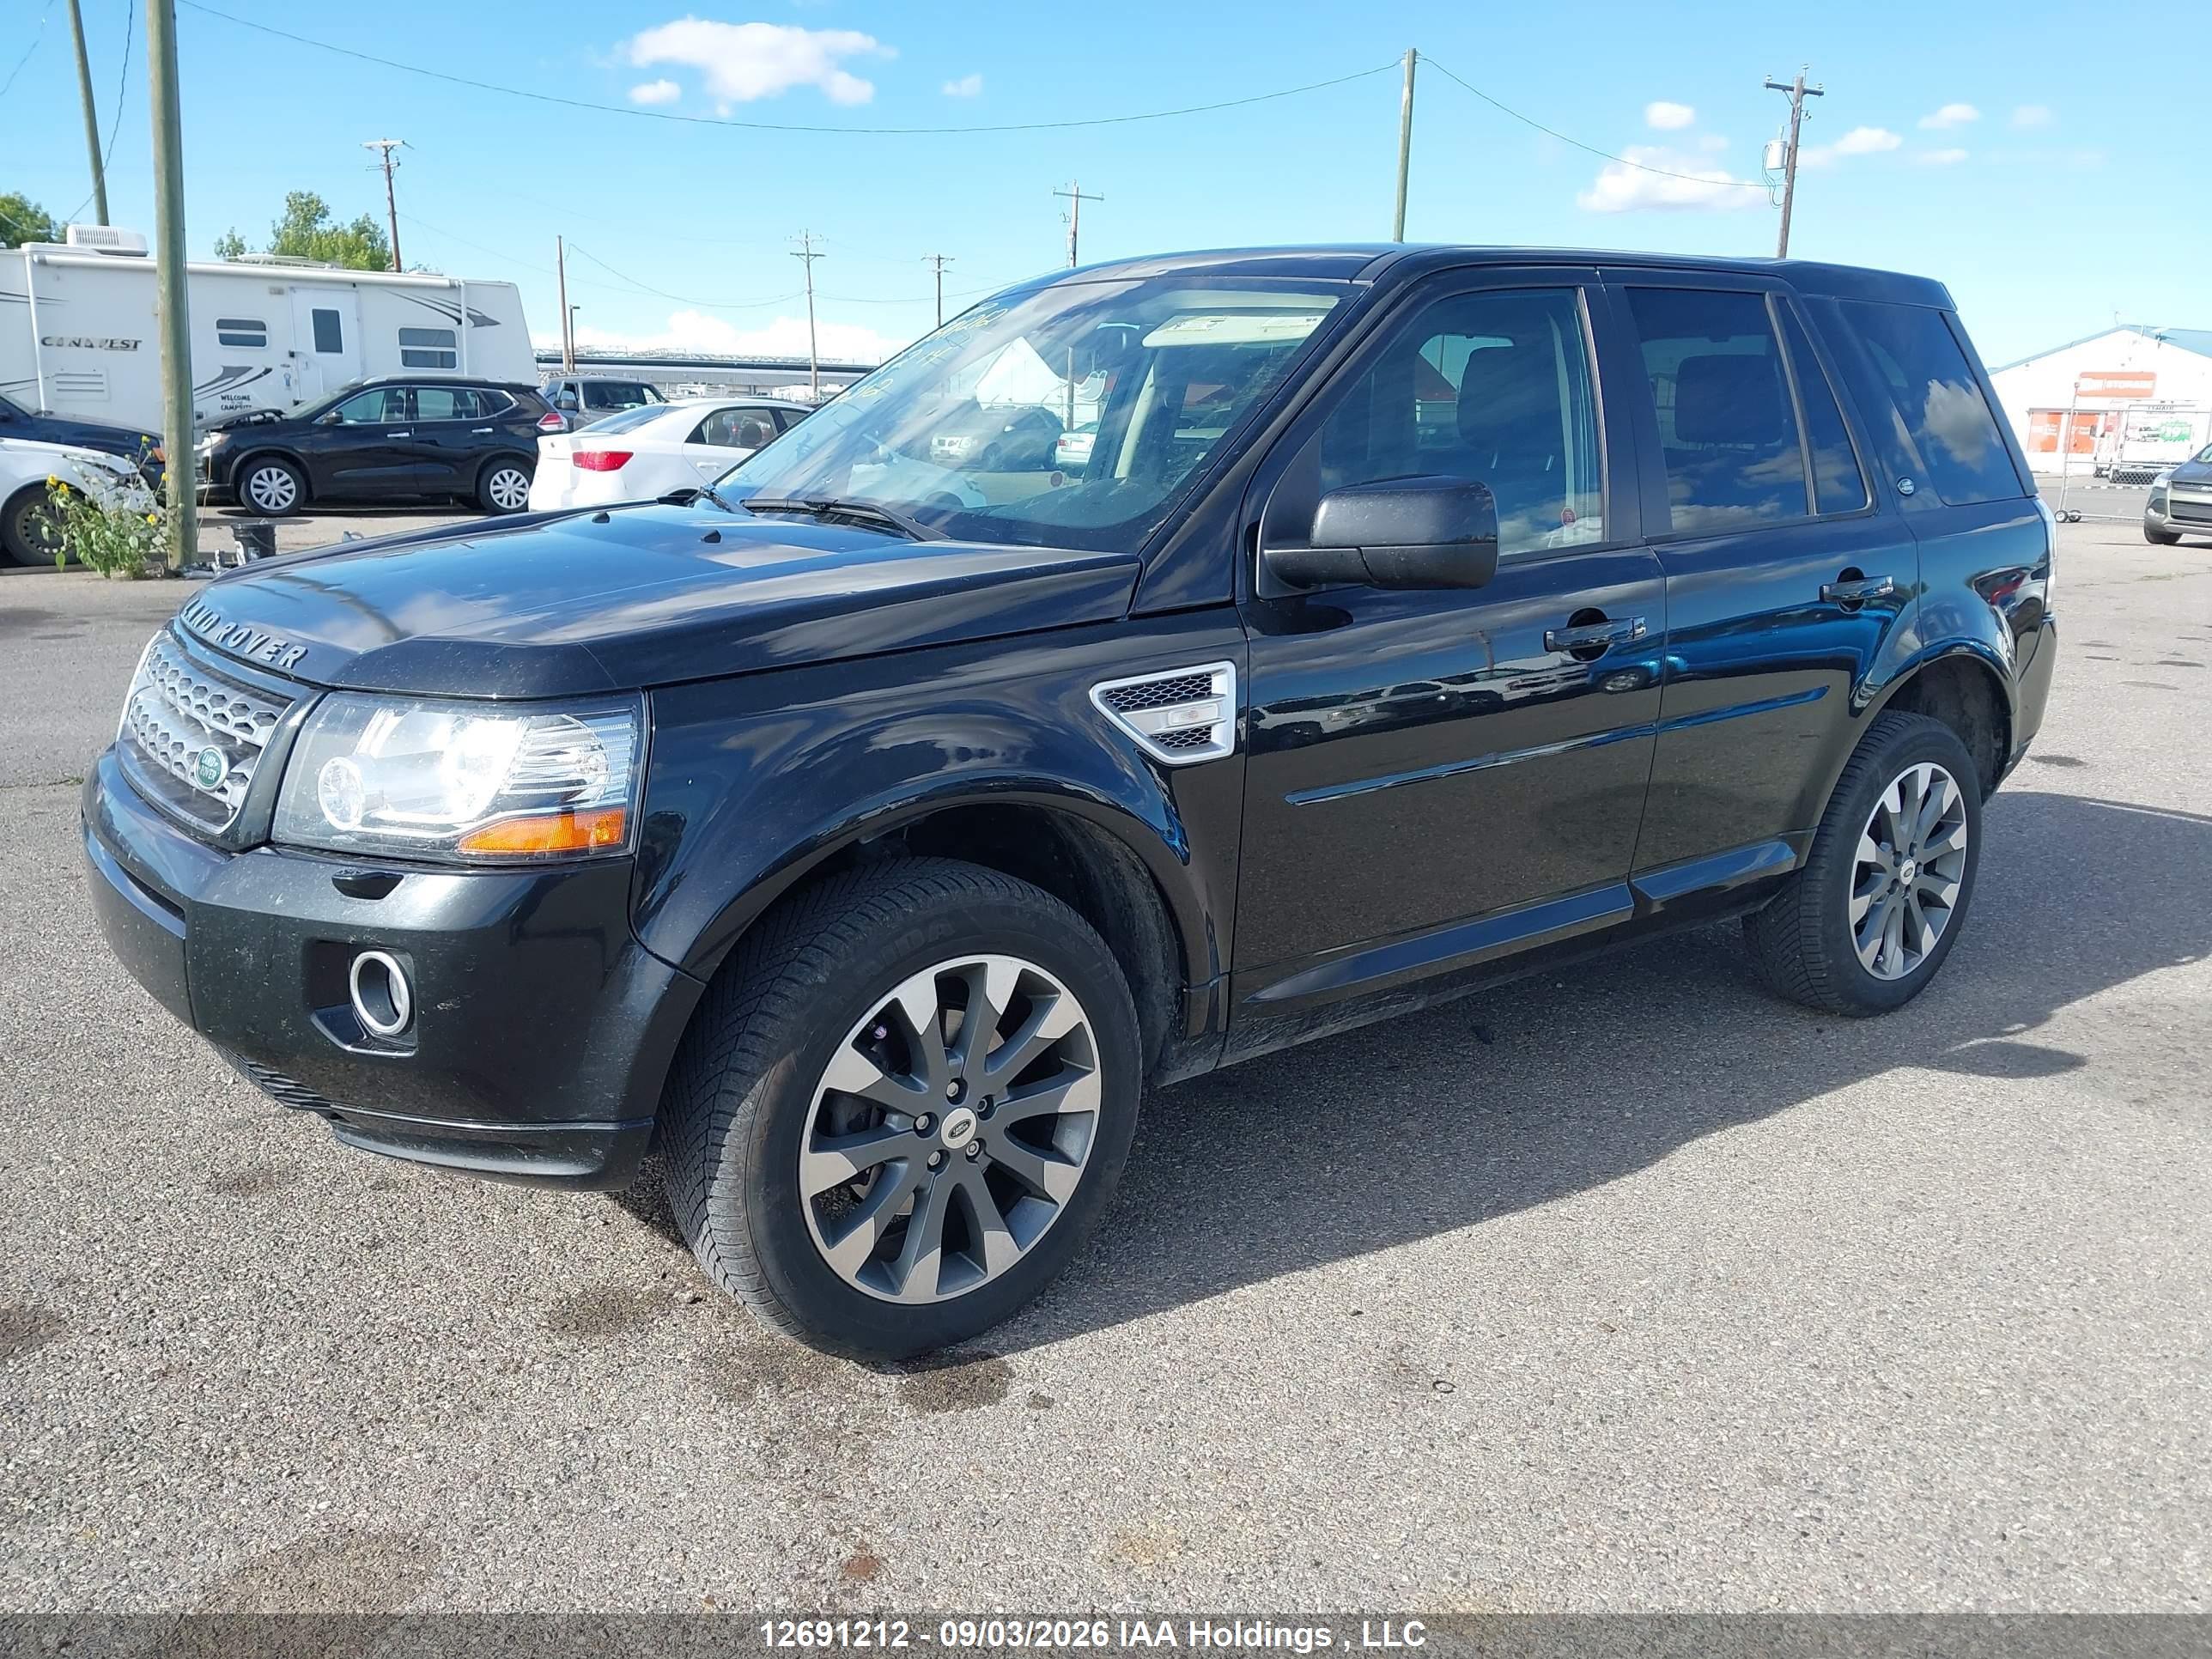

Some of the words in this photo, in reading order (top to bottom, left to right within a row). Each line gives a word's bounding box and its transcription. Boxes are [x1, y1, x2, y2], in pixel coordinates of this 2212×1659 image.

[180, 598, 221, 634] LAND
[215, 621, 308, 670] ROVER
[202, 753, 216, 767] LAND
[200, 767, 217, 781] ROVER
